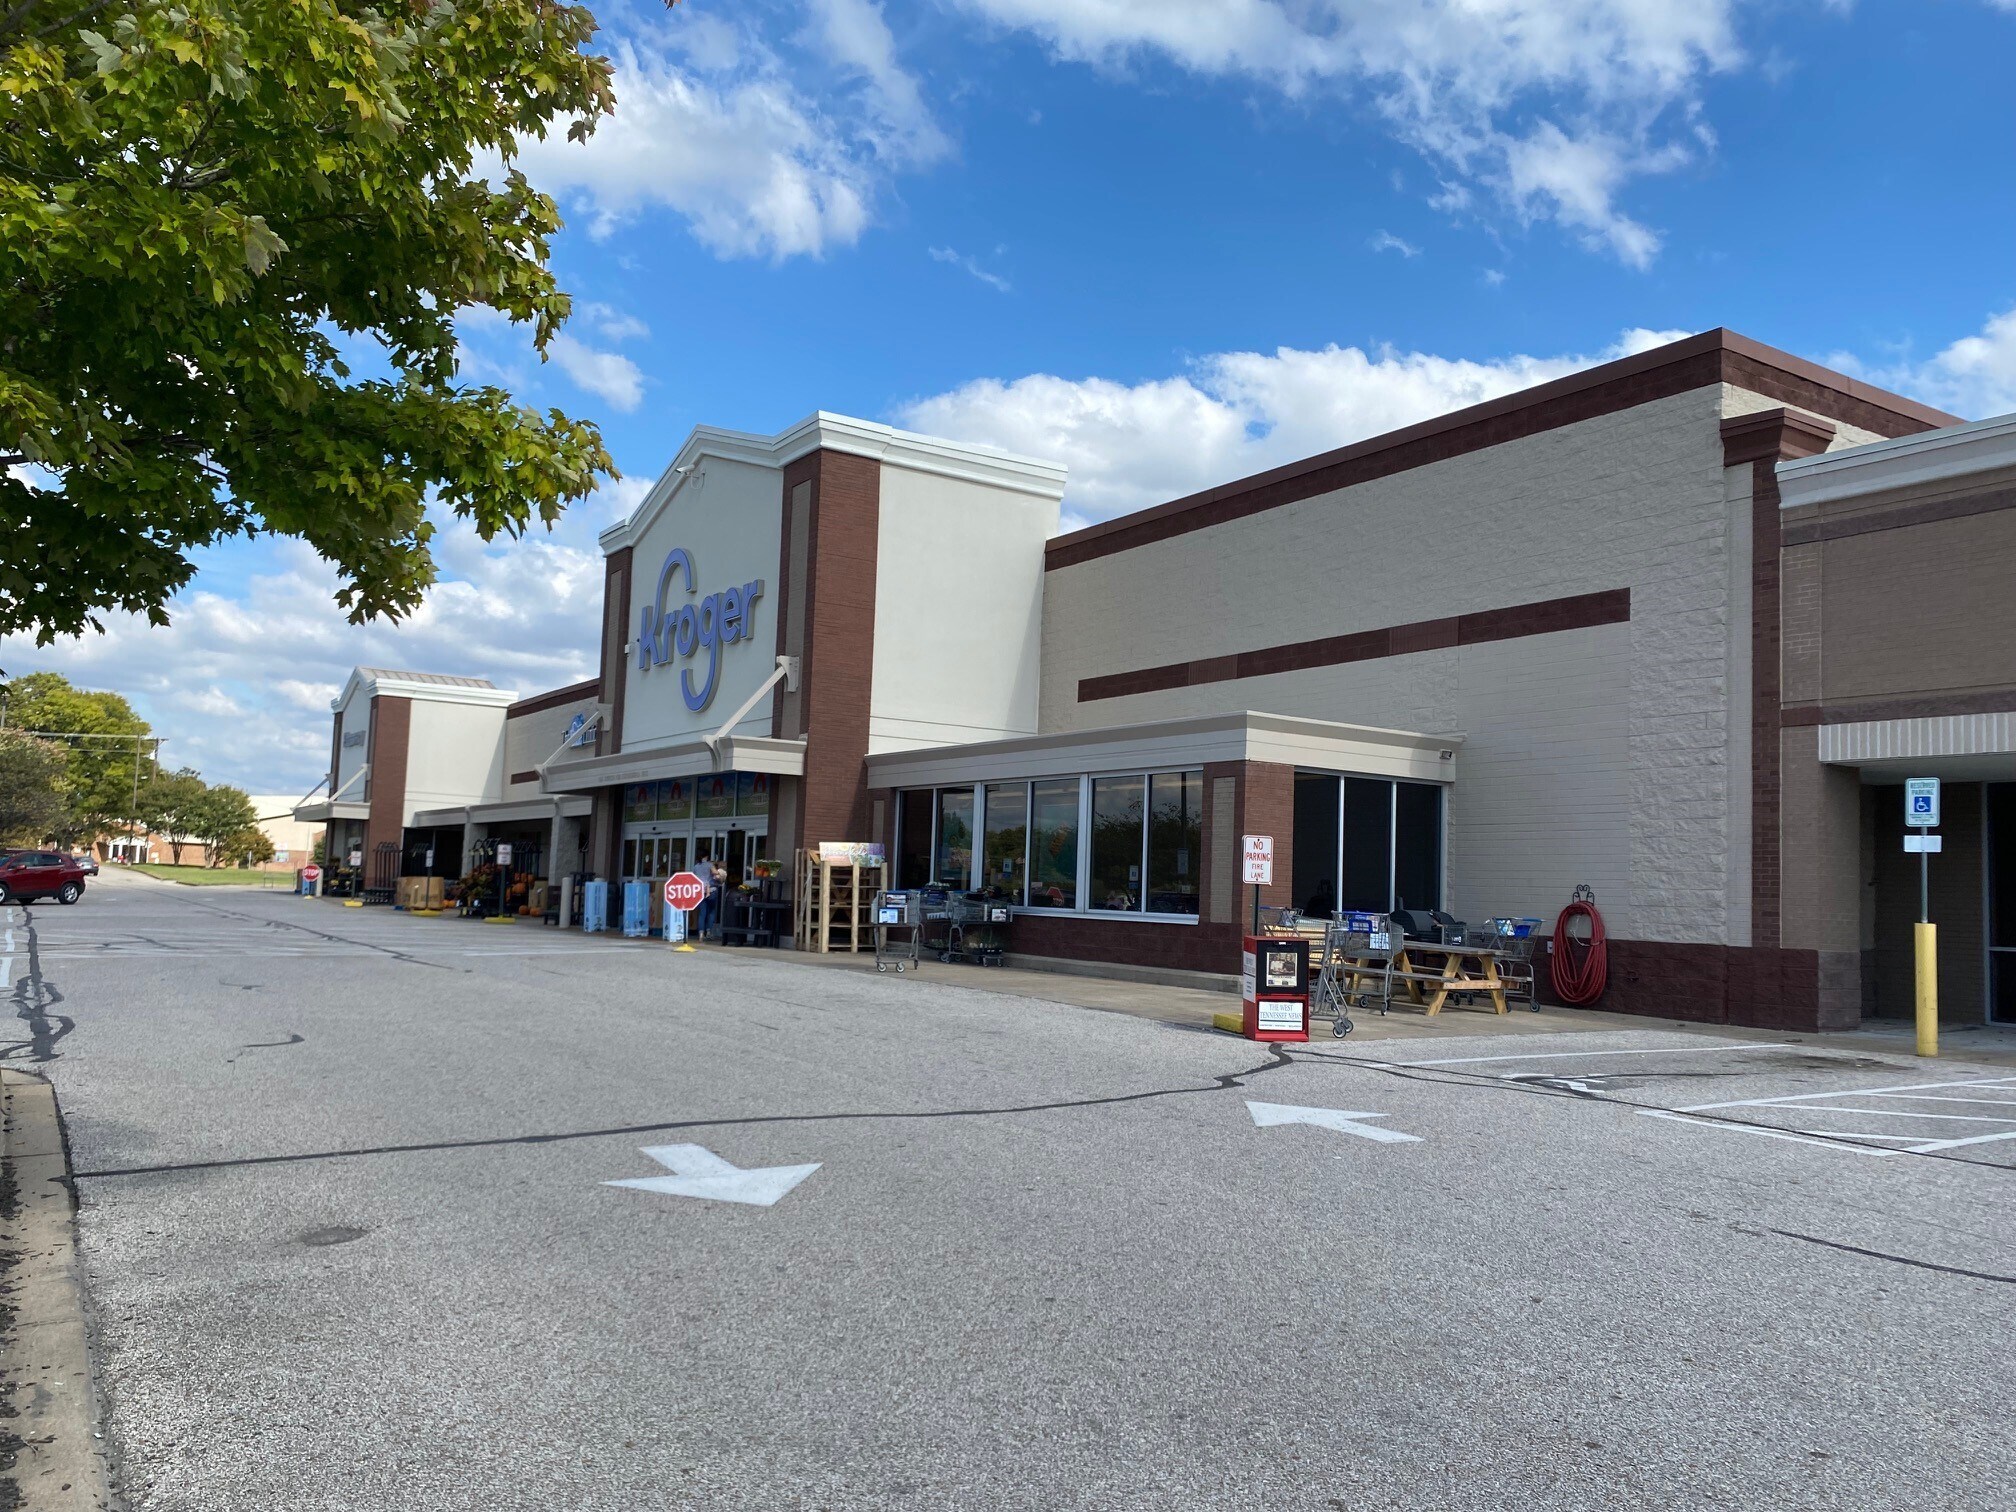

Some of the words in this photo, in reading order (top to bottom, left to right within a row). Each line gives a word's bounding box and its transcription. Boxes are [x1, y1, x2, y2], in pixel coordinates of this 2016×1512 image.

[638, 547, 765, 713] Kroger
[1253, 841, 1264, 851] NO
[1245, 851, 1271, 862] PARKING
[1251, 863, 1264, 871] FIRE
[303, 868, 320, 876] STOP
[668, 884, 701, 900] STOP
[1269, 1003, 1279, 1011] THE
[1259, 1011, 1287, 1019] TENNESSEE
